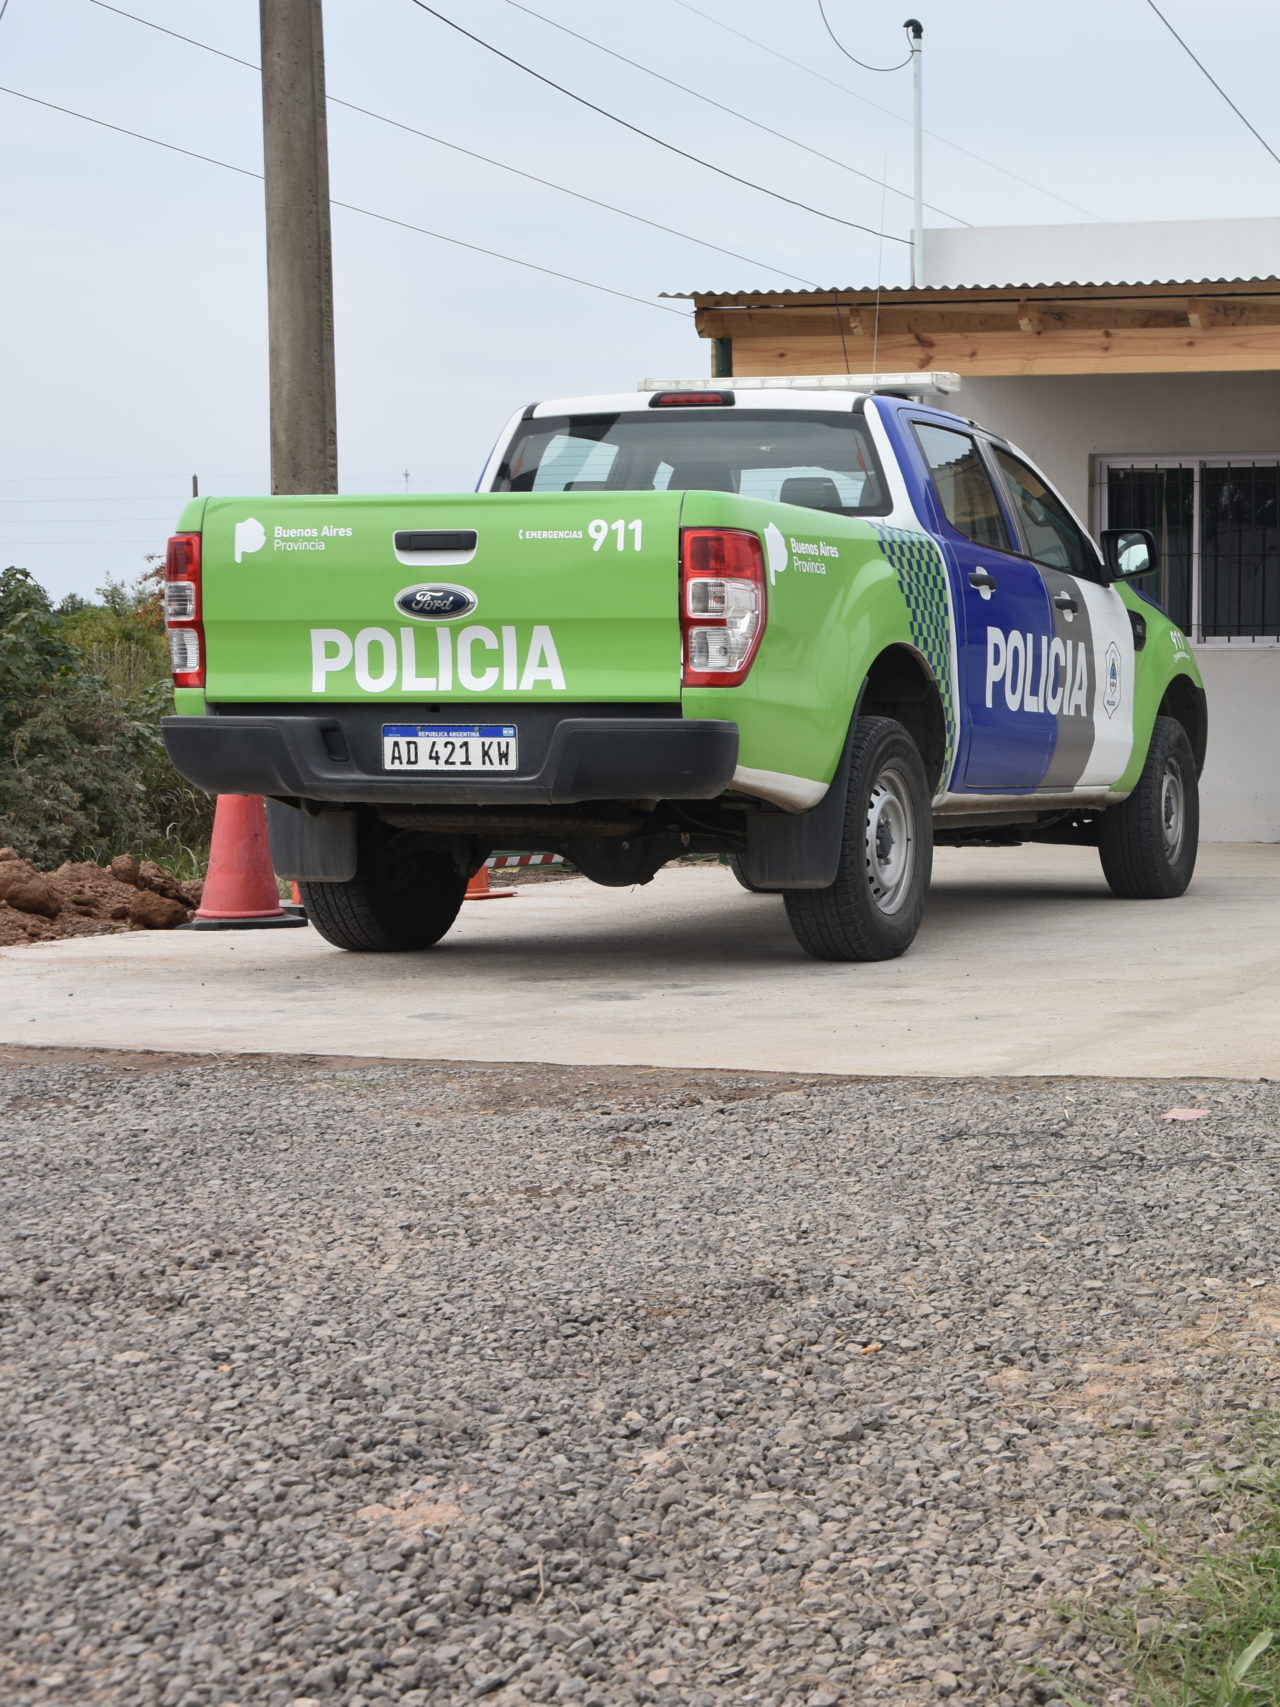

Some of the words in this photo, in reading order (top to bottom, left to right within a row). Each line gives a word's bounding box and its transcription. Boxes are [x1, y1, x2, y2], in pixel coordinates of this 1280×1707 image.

[273, 526, 319, 538] Buenos
[320, 525, 353, 537] Aires
[525, 530, 584, 539] EMERGENCIAS
[587, 518, 643, 552] 911
[273, 538, 326, 551] Provincia
[790, 537, 819, 556] Buenos
[819, 541, 840, 558] Aires
[792, 556, 827, 575] Provincia
[411, 590, 454, 611] Ford
[1169, 630, 1185, 650] 911
[310, 625, 567, 693] POLICIA
[985, 626, 1088, 717] POLICIA
[390, 740, 419, 766] AD
[428, 740, 472, 766] 421
[481, 740, 510, 766] KW
